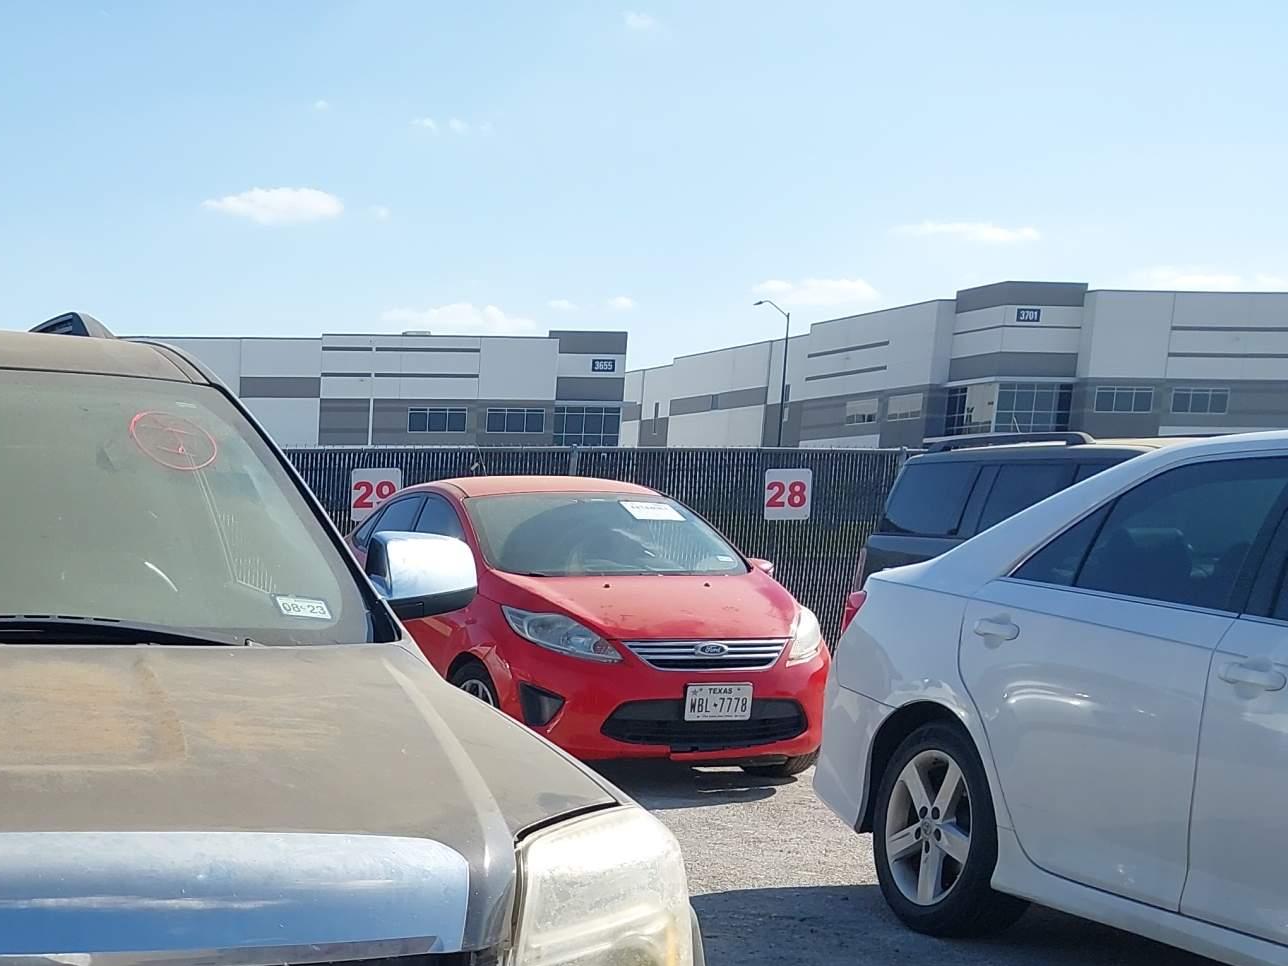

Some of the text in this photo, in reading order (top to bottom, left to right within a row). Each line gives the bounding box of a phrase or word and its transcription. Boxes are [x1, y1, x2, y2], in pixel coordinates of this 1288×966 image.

[1019, 310, 1038, 321] 3701
[352, 480, 397, 509] 29
[765, 480, 807, 508] 28
[708, 687, 733, 695] TEXAS
